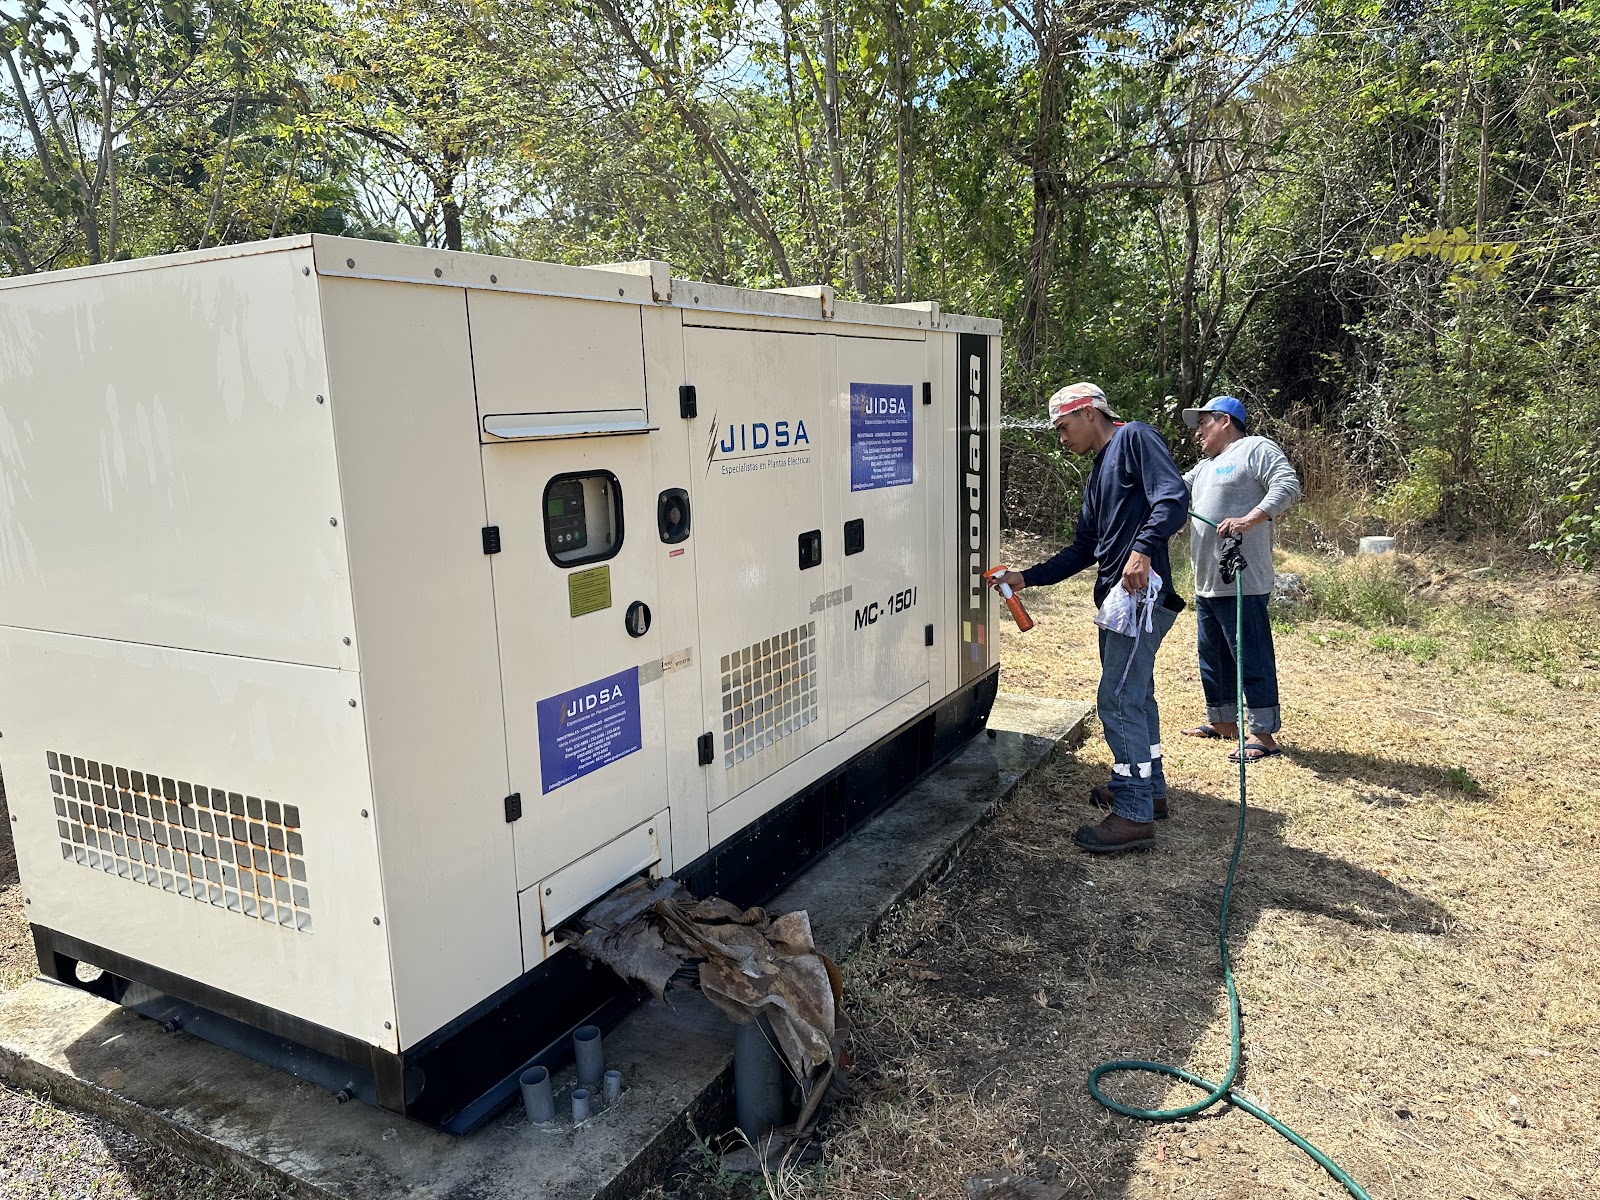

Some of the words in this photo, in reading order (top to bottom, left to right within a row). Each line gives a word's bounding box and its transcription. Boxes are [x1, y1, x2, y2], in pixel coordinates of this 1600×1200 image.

[865, 397, 905, 413] JIDSA
[721, 419, 809, 453] JIDSA
[722, 462, 758, 476] Especialistas
[760, 462, 766, 470] en
[767, 459, 786, 468] Plantas
[966, 354, 981, 609] modasa
[567, 685, 622, 717] JIDSA
[567, 715, 590, 727] Especialistas
